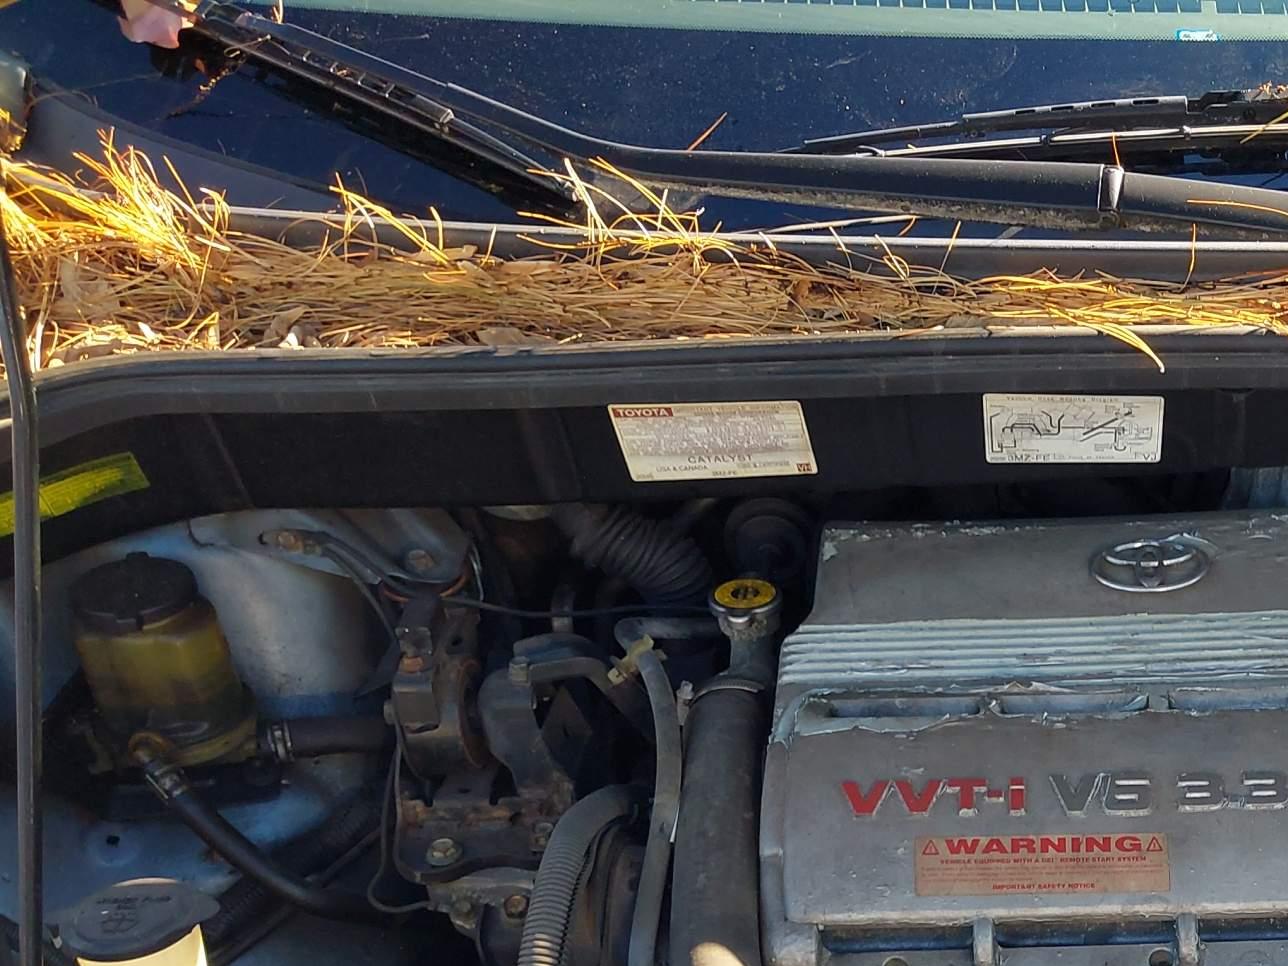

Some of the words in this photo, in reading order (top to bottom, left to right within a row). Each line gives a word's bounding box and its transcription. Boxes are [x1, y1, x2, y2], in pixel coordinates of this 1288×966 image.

[617, 407, 669, 418] TOYOTA
[688, 454, 752, 465] CATALYST
[840, 776, 1028, 817] VVT-i
[1048, 772, 1155, 817] V6
[944, 835, 1143, 855] WARNING
